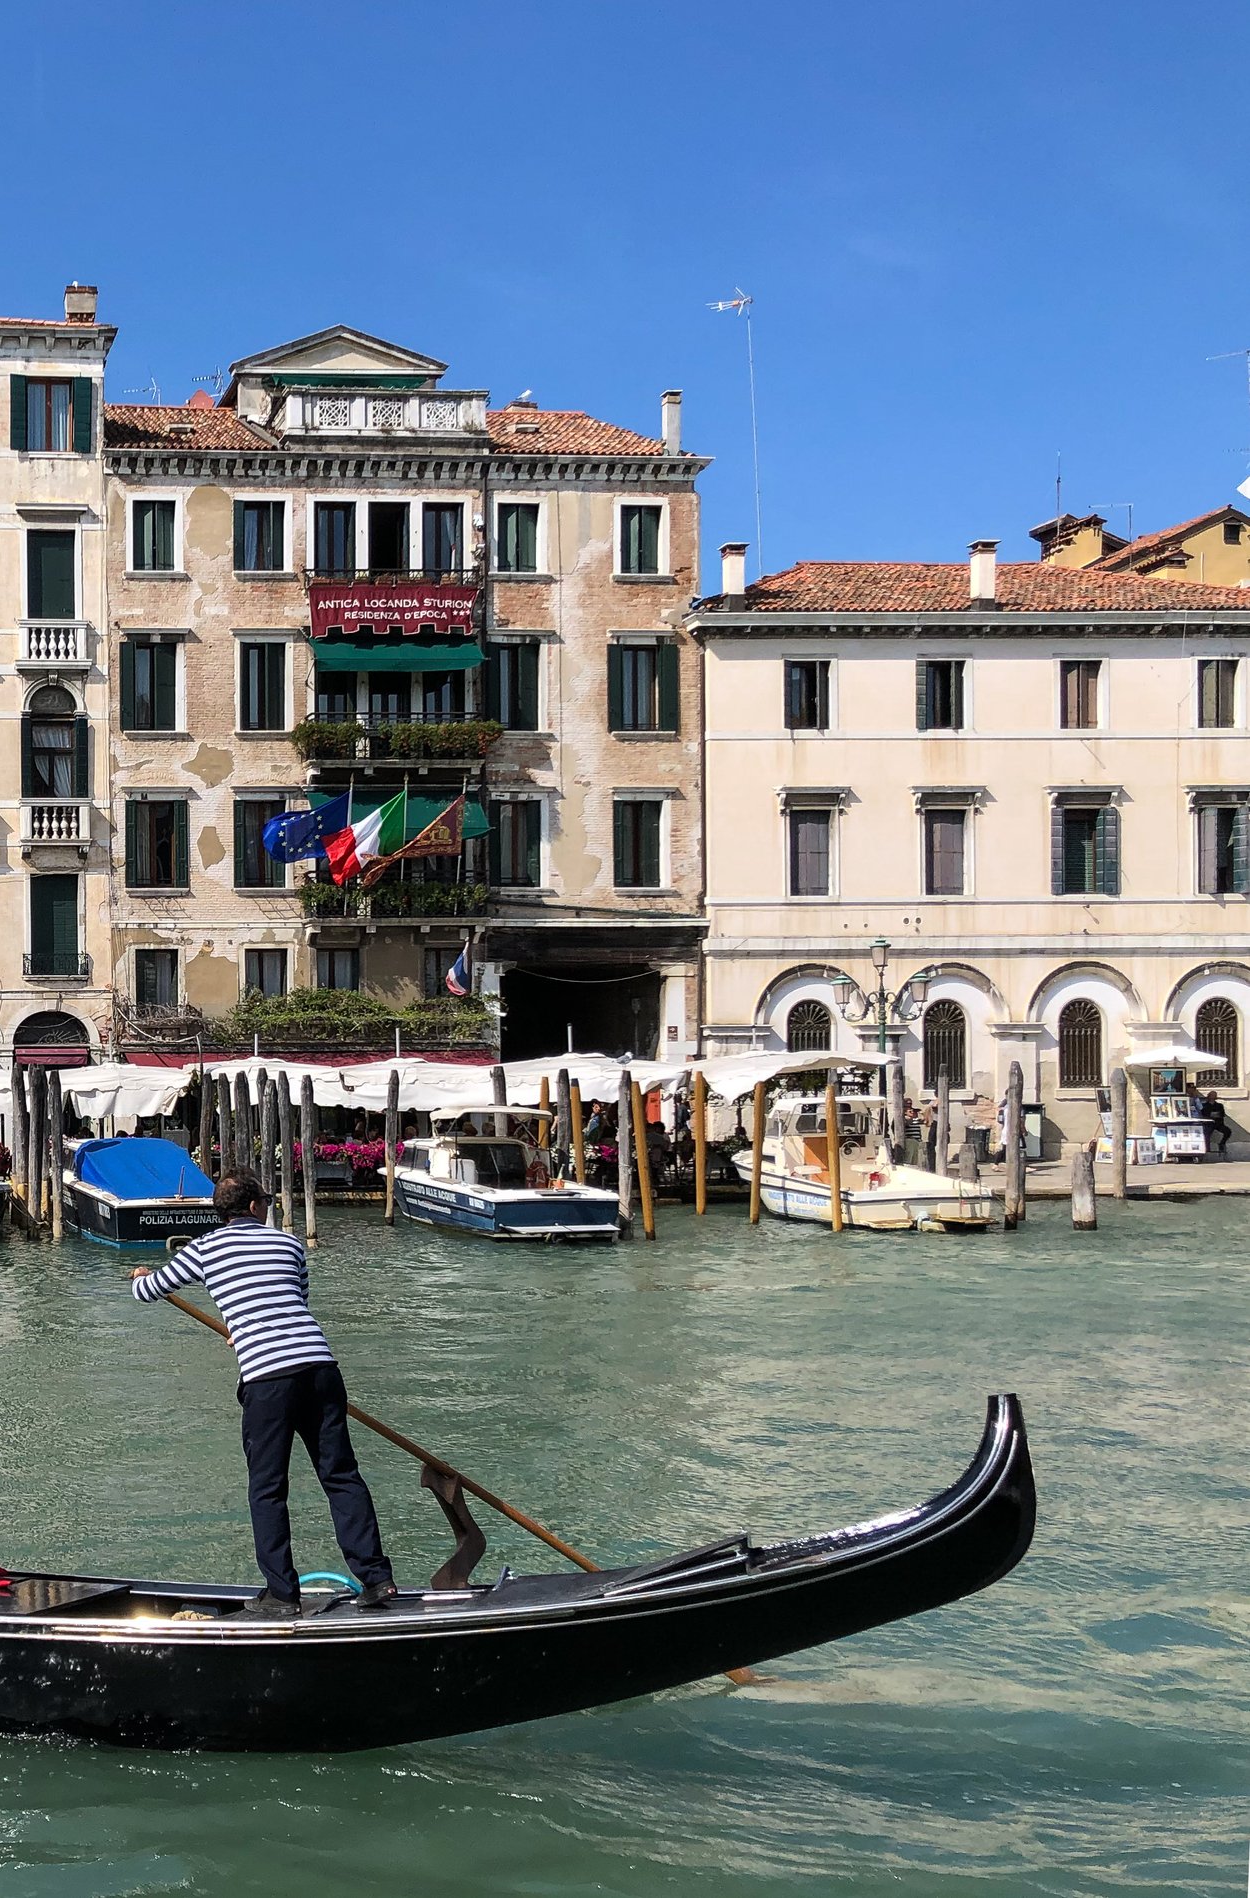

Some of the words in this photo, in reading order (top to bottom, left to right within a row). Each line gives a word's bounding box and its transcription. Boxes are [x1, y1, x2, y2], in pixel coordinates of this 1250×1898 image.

[318, 599, 360, 609] ANTICA
[365, 599, 420, 608] LOCANDA
[423, 598, 473, 609] STURION
[344, 610, 400, 620] RESIDENZA
[139, 1215, 174, 1225] POLIZIA
